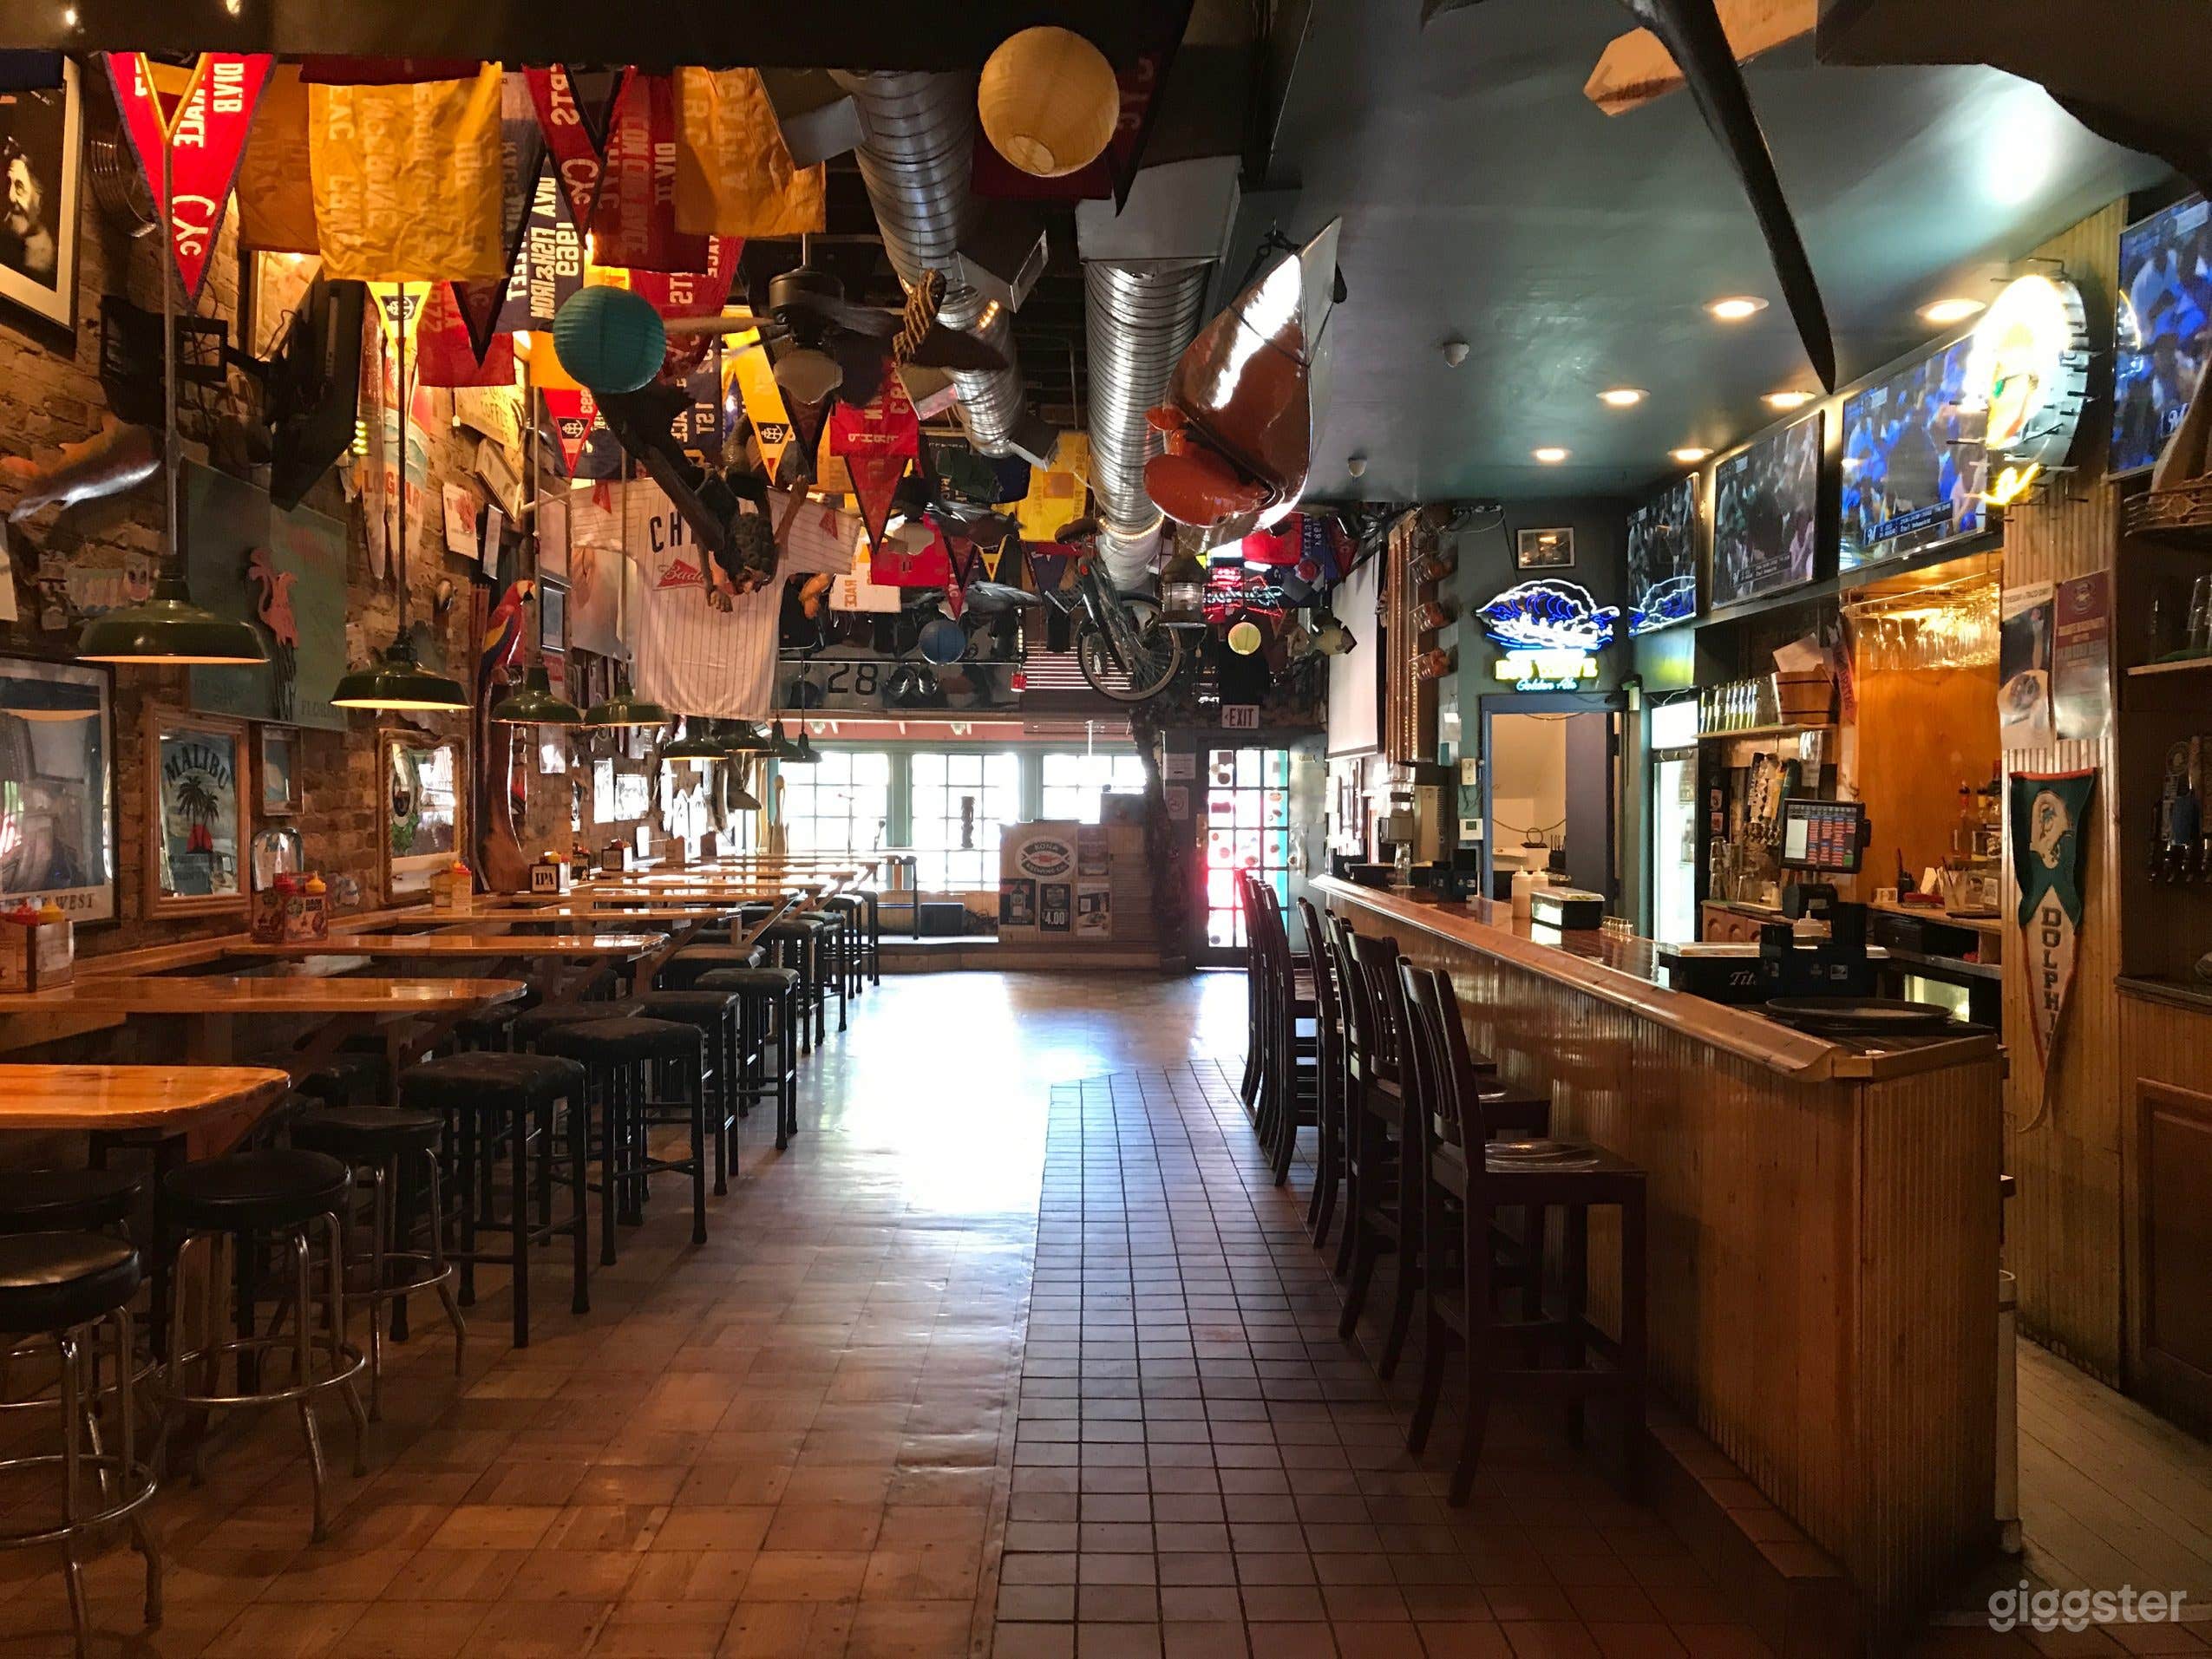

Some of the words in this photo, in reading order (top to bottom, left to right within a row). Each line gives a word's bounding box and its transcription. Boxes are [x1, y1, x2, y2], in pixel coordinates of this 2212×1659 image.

[649, 510, 699, 552] CH
[828, 662, 878, 696] 28
[1229, 708, 1254, 727] EXIT
[164, 743, 231, 790] MALIBU
[1034, 840, 1059, 852] KONA
[534, 872, 554, 886] IPA
[1730, 970, 1757, 986] Tit
